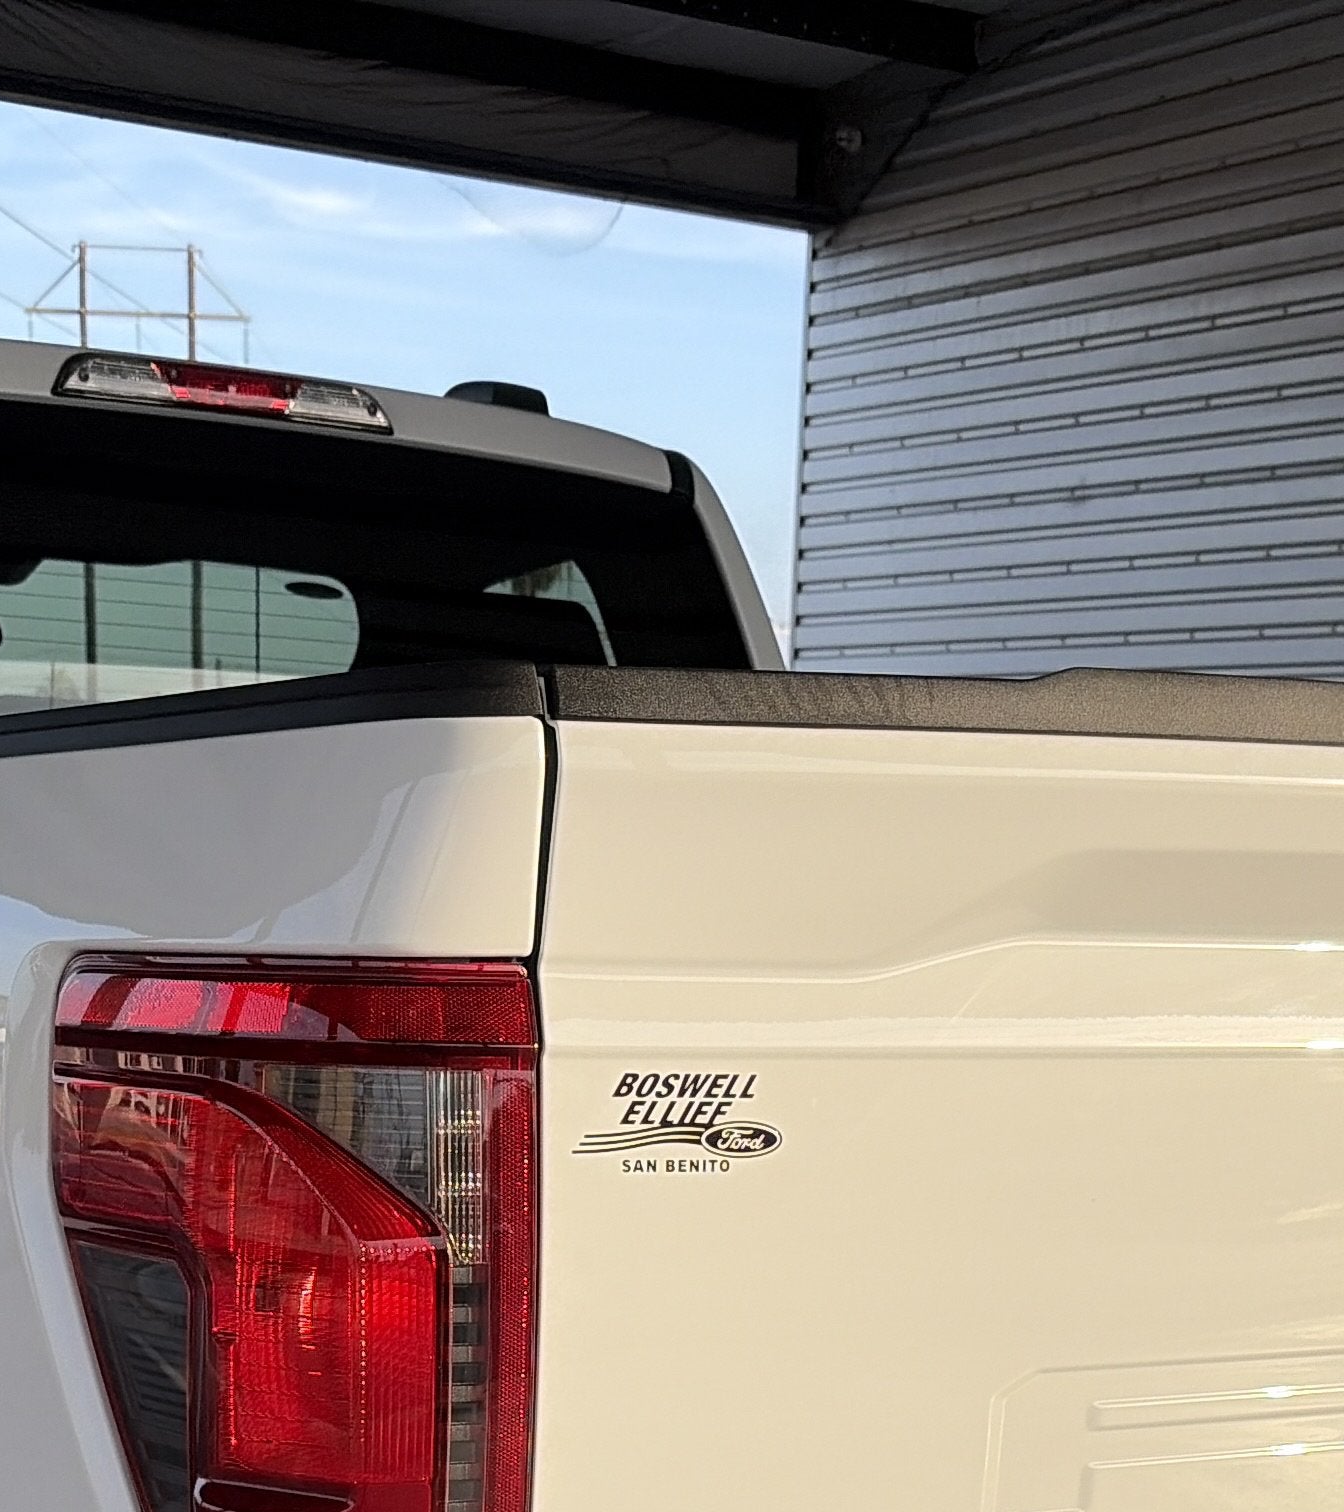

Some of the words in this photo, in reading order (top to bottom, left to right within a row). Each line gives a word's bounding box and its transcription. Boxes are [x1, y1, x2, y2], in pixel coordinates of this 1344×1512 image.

[612, 1073, 757, 1098] BOSWELL
[619, 1101, 733, 1126] ELLIFF
[716, 1128, 765, 1150] Ford
[622, 1160, 656, 1173] SAN
[665, 1160, 730, 1173] BENITO
